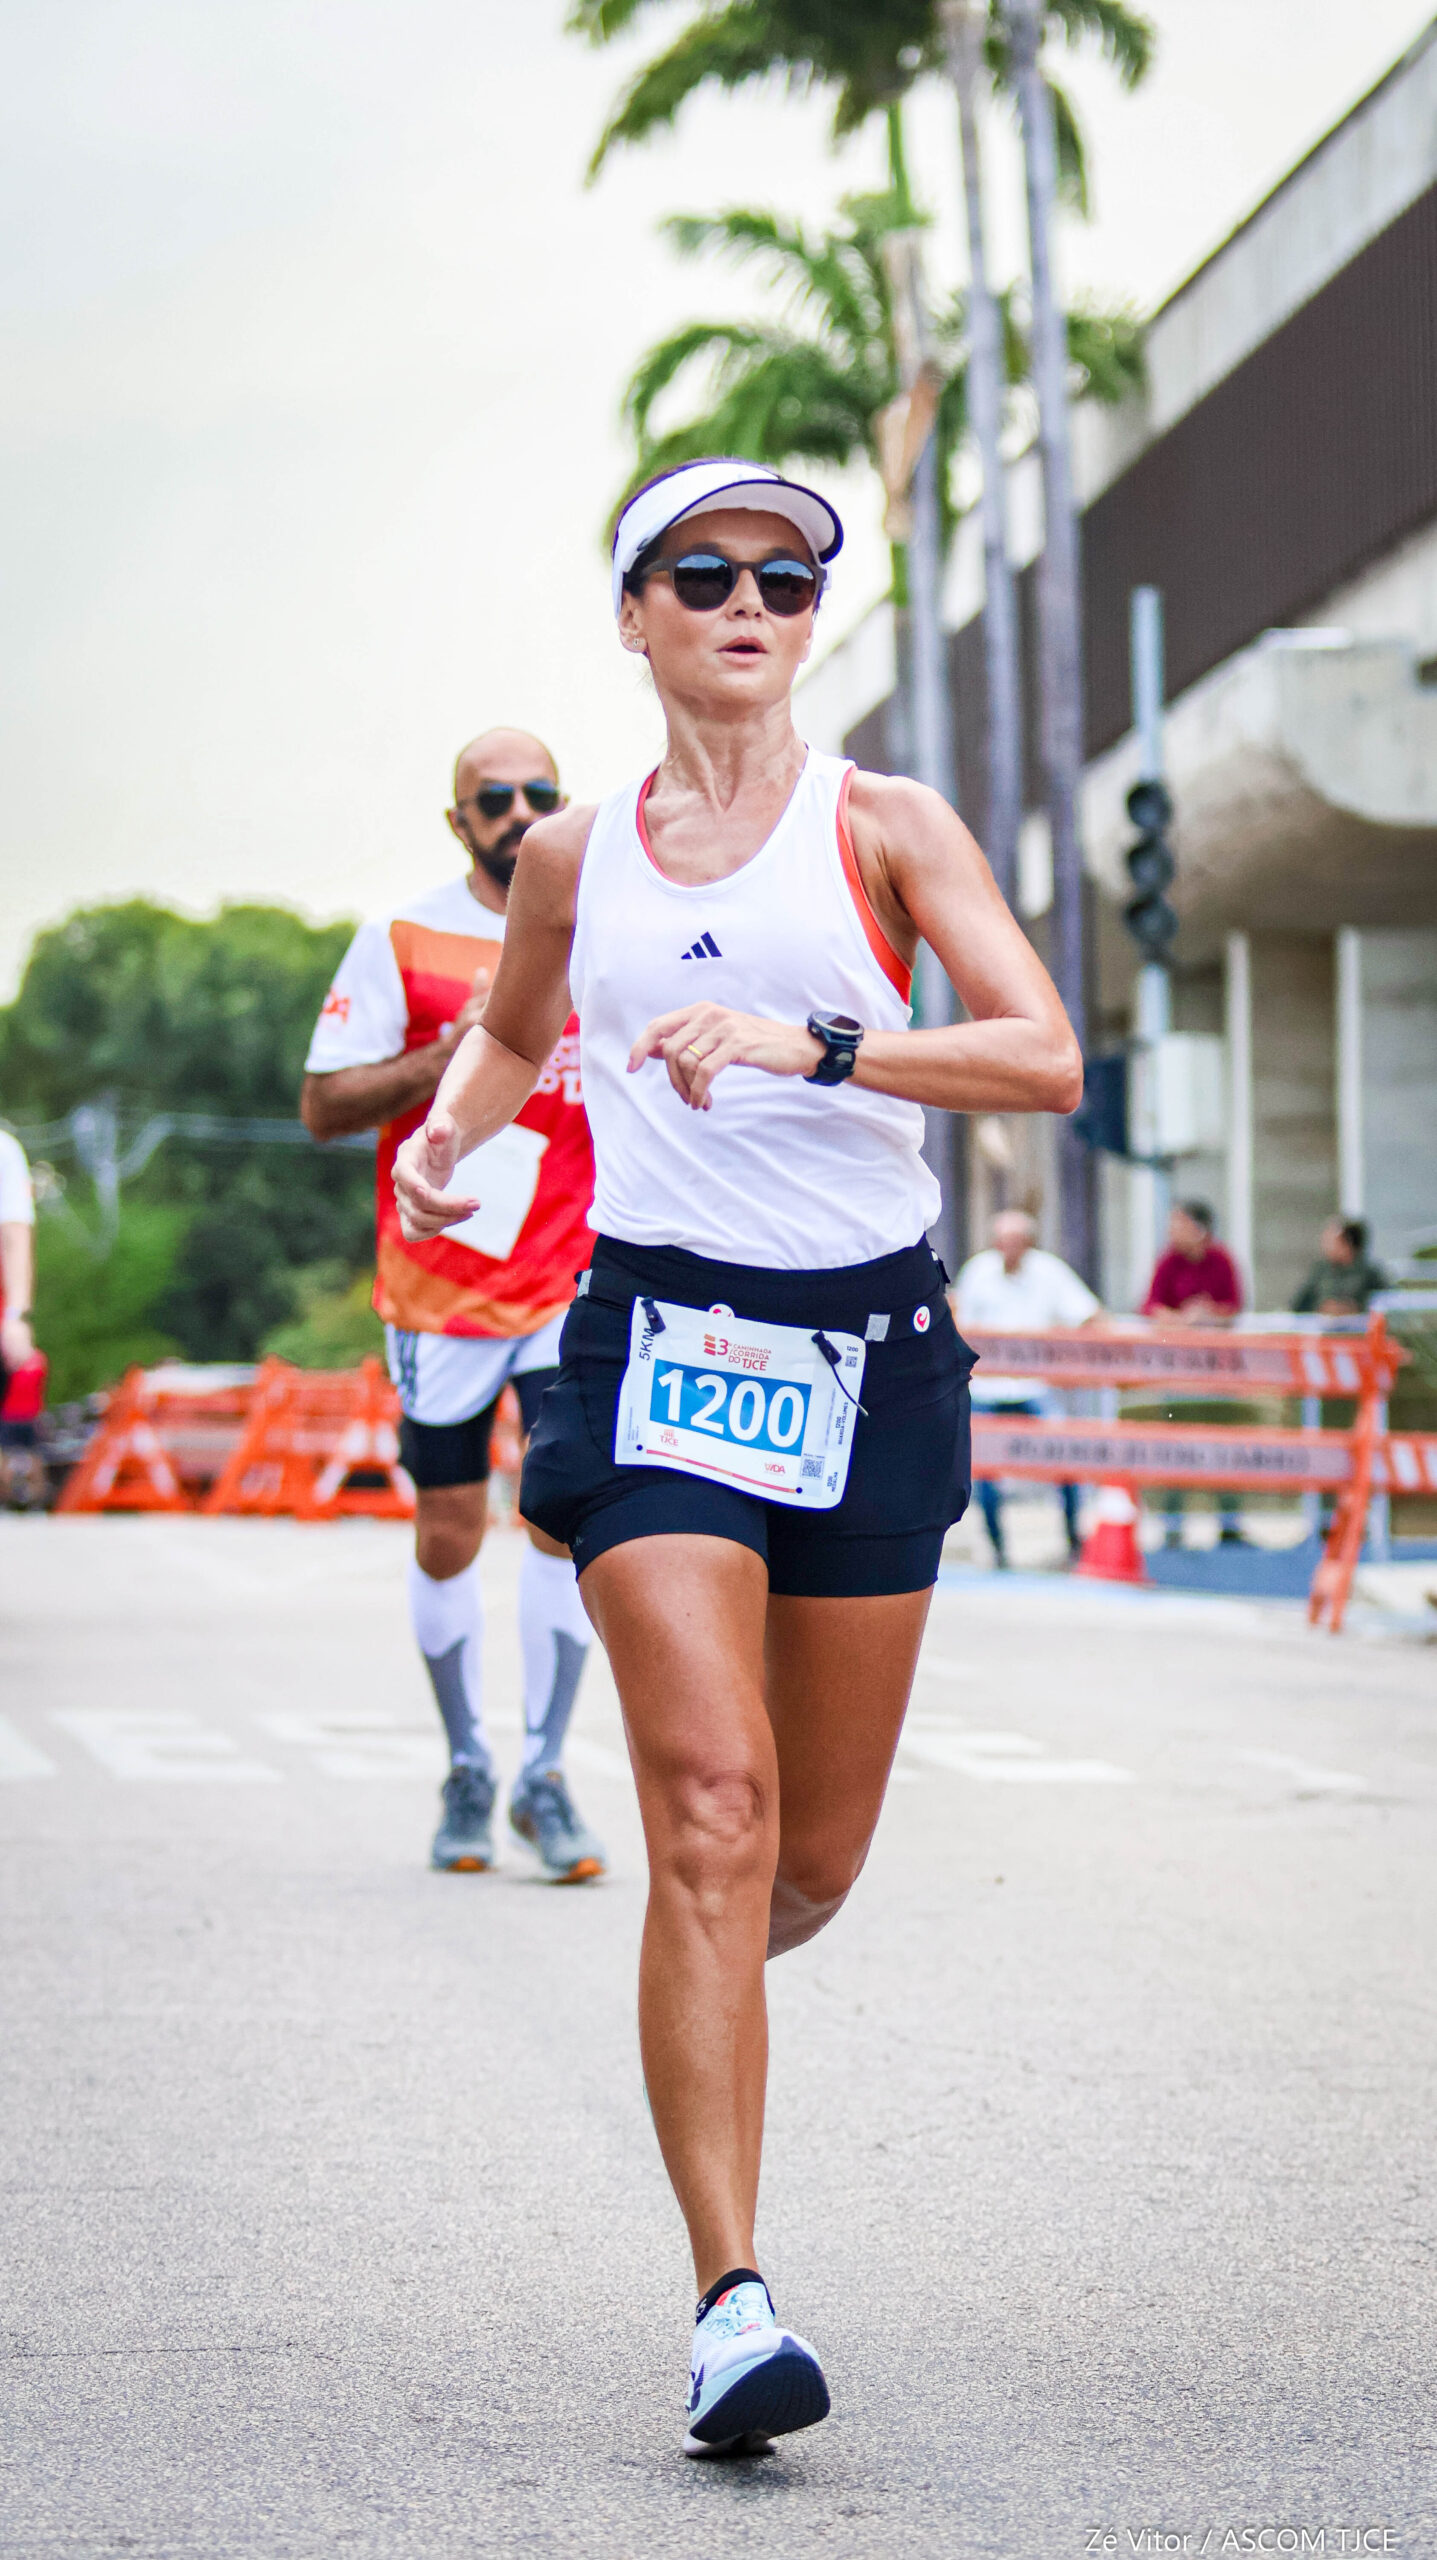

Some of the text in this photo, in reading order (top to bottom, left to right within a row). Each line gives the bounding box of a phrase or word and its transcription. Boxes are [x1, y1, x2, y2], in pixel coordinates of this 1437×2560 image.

[639, 1327, 655, 1360] 5KM
[728, 1355, 767, 1371] DO TJCE
[657, 1367, 805, 1448] 1200
[659, 1435, 679, 1447] TJCE
